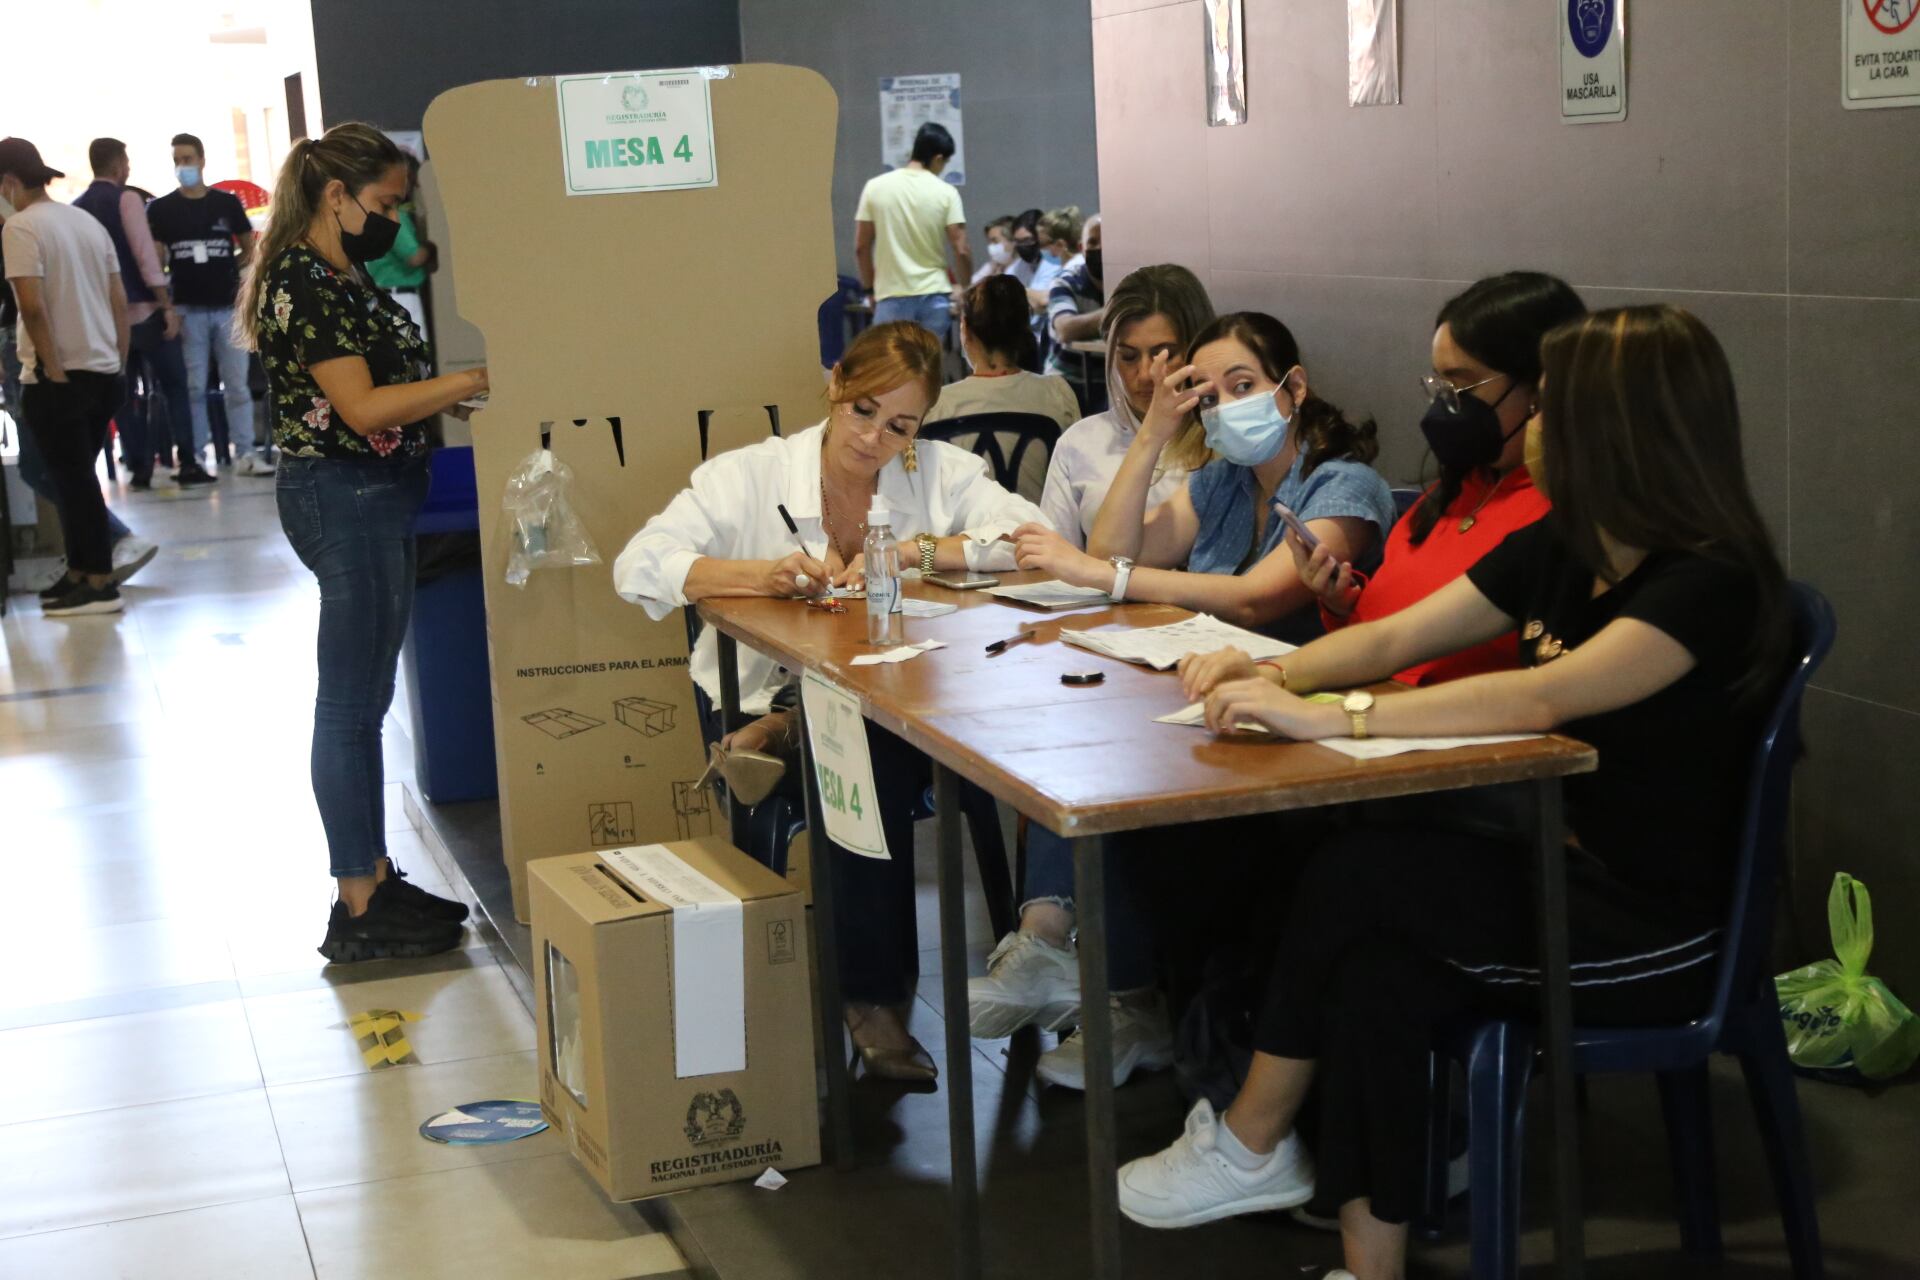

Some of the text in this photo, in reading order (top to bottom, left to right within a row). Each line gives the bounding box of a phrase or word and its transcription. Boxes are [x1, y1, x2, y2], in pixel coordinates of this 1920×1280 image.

[1855, 49, 1920, 67] EVITA TOCART
[1583, 72, 1599, 85] USA
[1870, 65, 1909, 80] LA CARA
[1567, 84, 1616, 100] MASCARILLA
[585, 134, 693, 169] MESA 4
[516, 662, 606, 678] INSTRUCCIONES
[609, 659, 639, 671] PARA
[641, 659, 655, 669] EL
[536, 762, 543, 770] A
[624, 755, 631, 763] B
[850, 783, 862, 820] 4
[650, 1138, 782, 1174] REGISTRADURÍA
[651, 1154, 783, 1183] NACIONAL DEL ESTADO CIVIL
